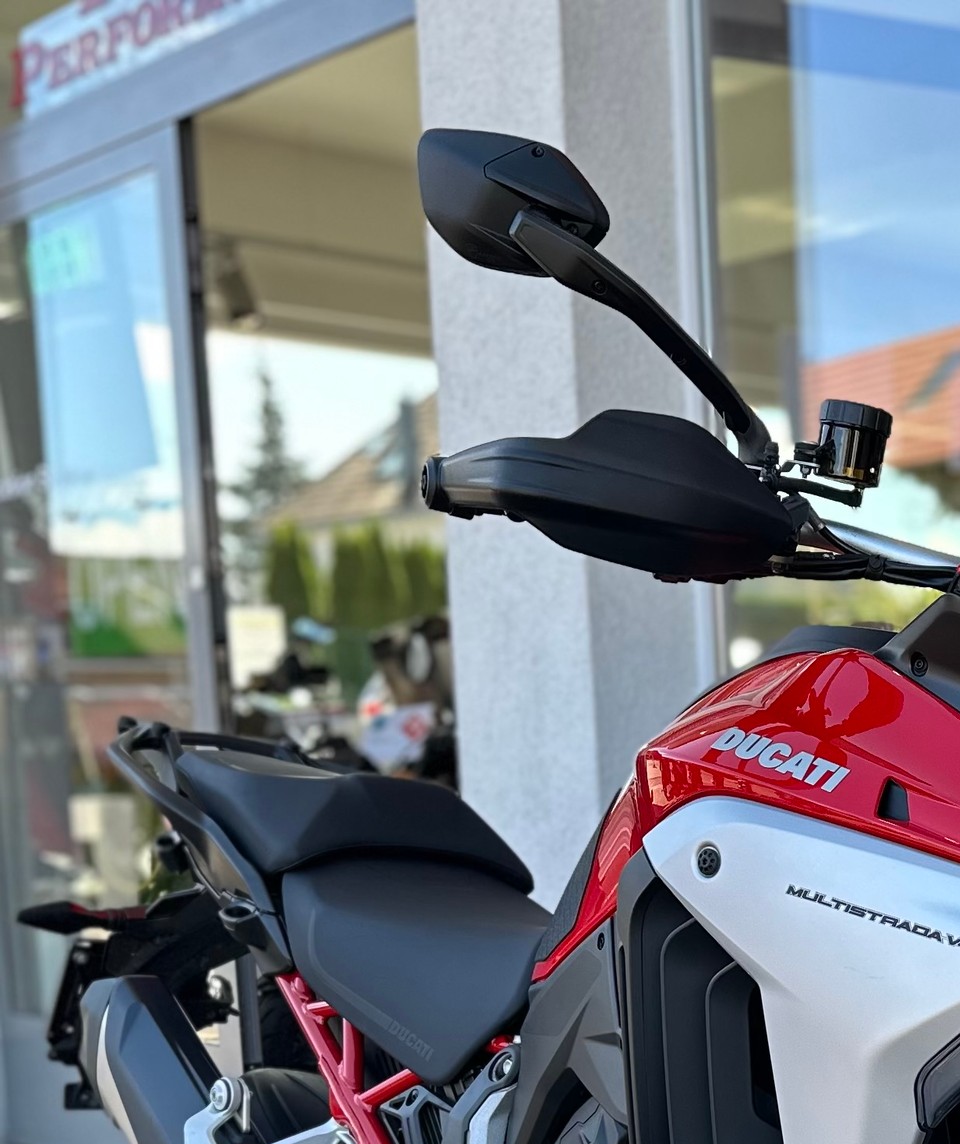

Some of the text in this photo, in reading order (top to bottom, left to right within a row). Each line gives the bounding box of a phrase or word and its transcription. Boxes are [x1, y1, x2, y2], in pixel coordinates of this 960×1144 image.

[710, 726, 851, 793] DUCATI
[785, 884, 944, 945] MULTISTRADA
[388, 1019, 435, 1063] DUCATI
